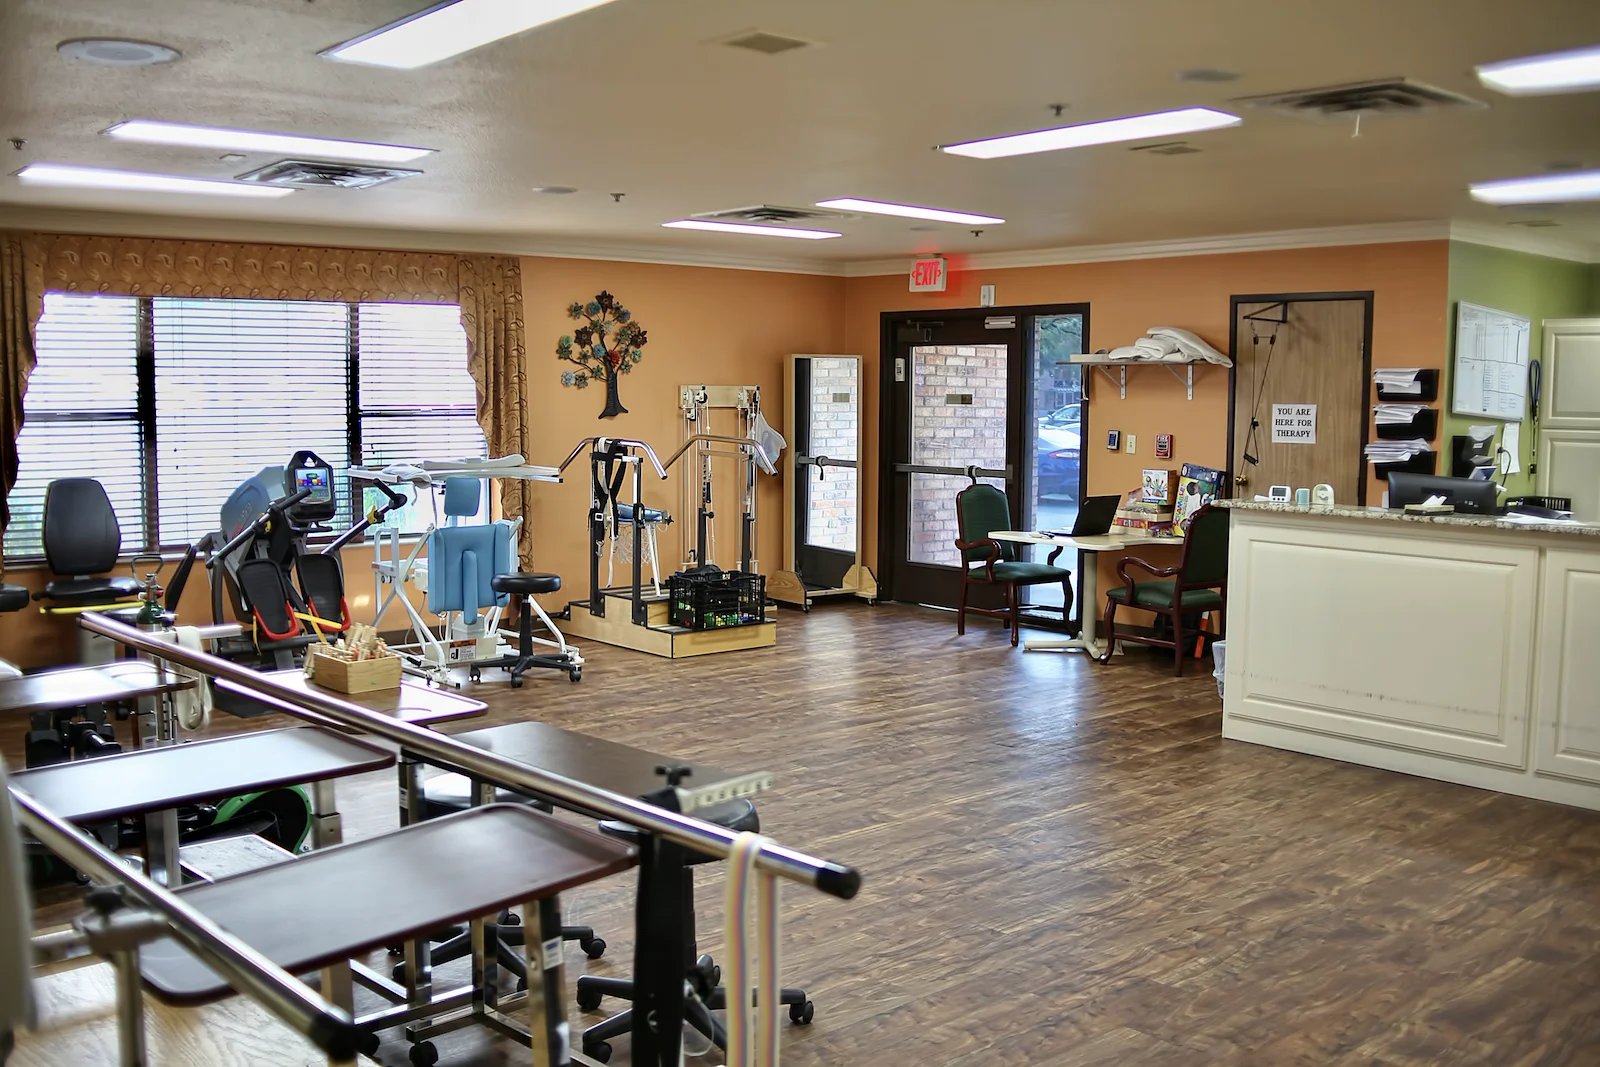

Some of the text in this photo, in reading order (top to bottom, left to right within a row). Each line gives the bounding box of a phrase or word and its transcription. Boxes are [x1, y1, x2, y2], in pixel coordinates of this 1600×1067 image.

[915, 260, 940, 286] EXIT
[1277, 407, 1312, 416] YOU ARE
[1275, 418, 1313, 427] HERE FOR
[1276, 429, 1311, 438] THERAPY
